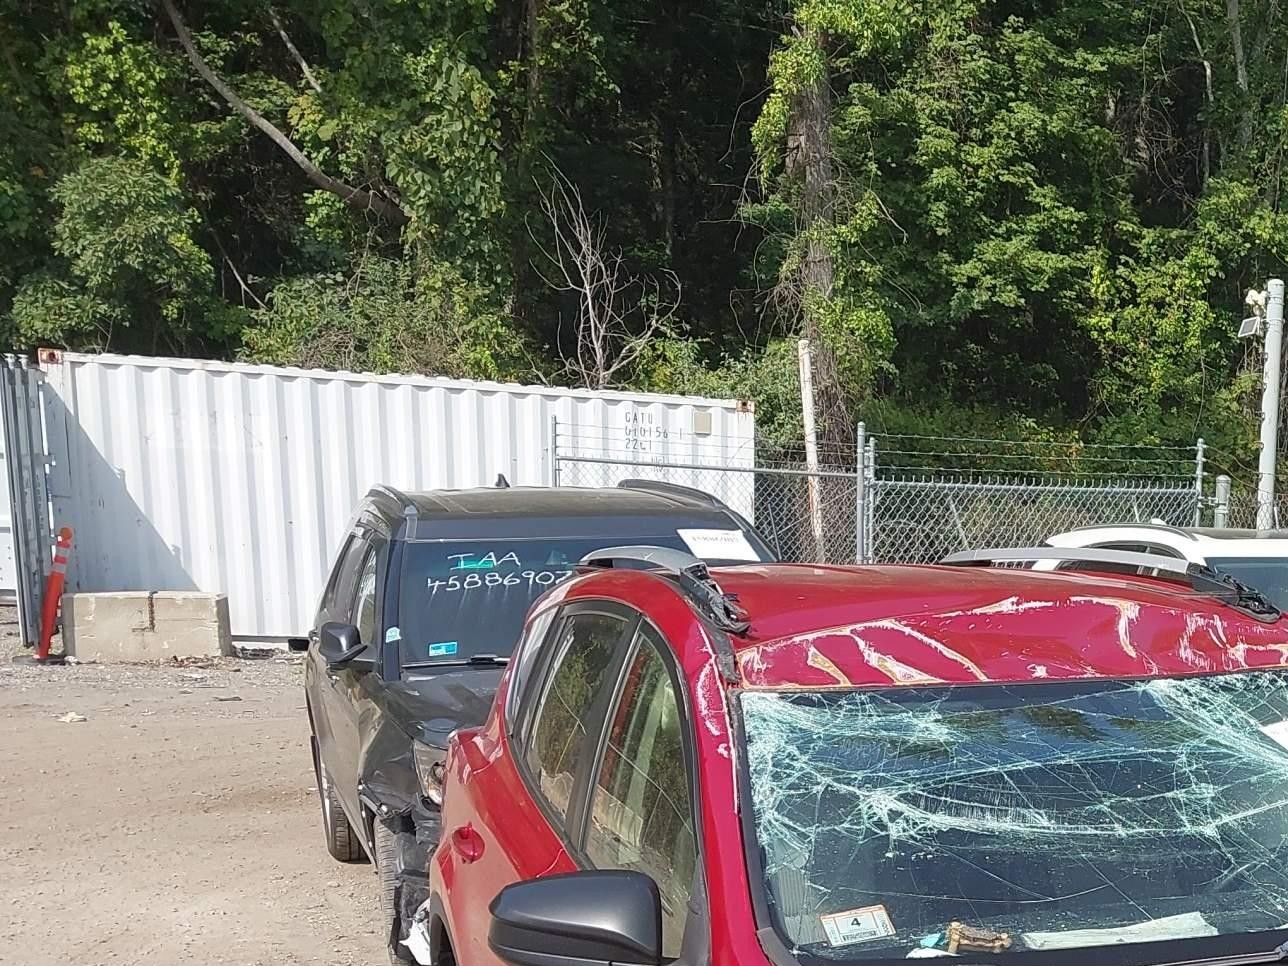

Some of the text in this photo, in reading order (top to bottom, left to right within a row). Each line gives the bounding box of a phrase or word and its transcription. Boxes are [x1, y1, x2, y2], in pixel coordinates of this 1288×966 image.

[625, 411, 653, 424] GATU
[448, 552, 521, 570] IAA
[428, 570, 573, 594] 45886907
